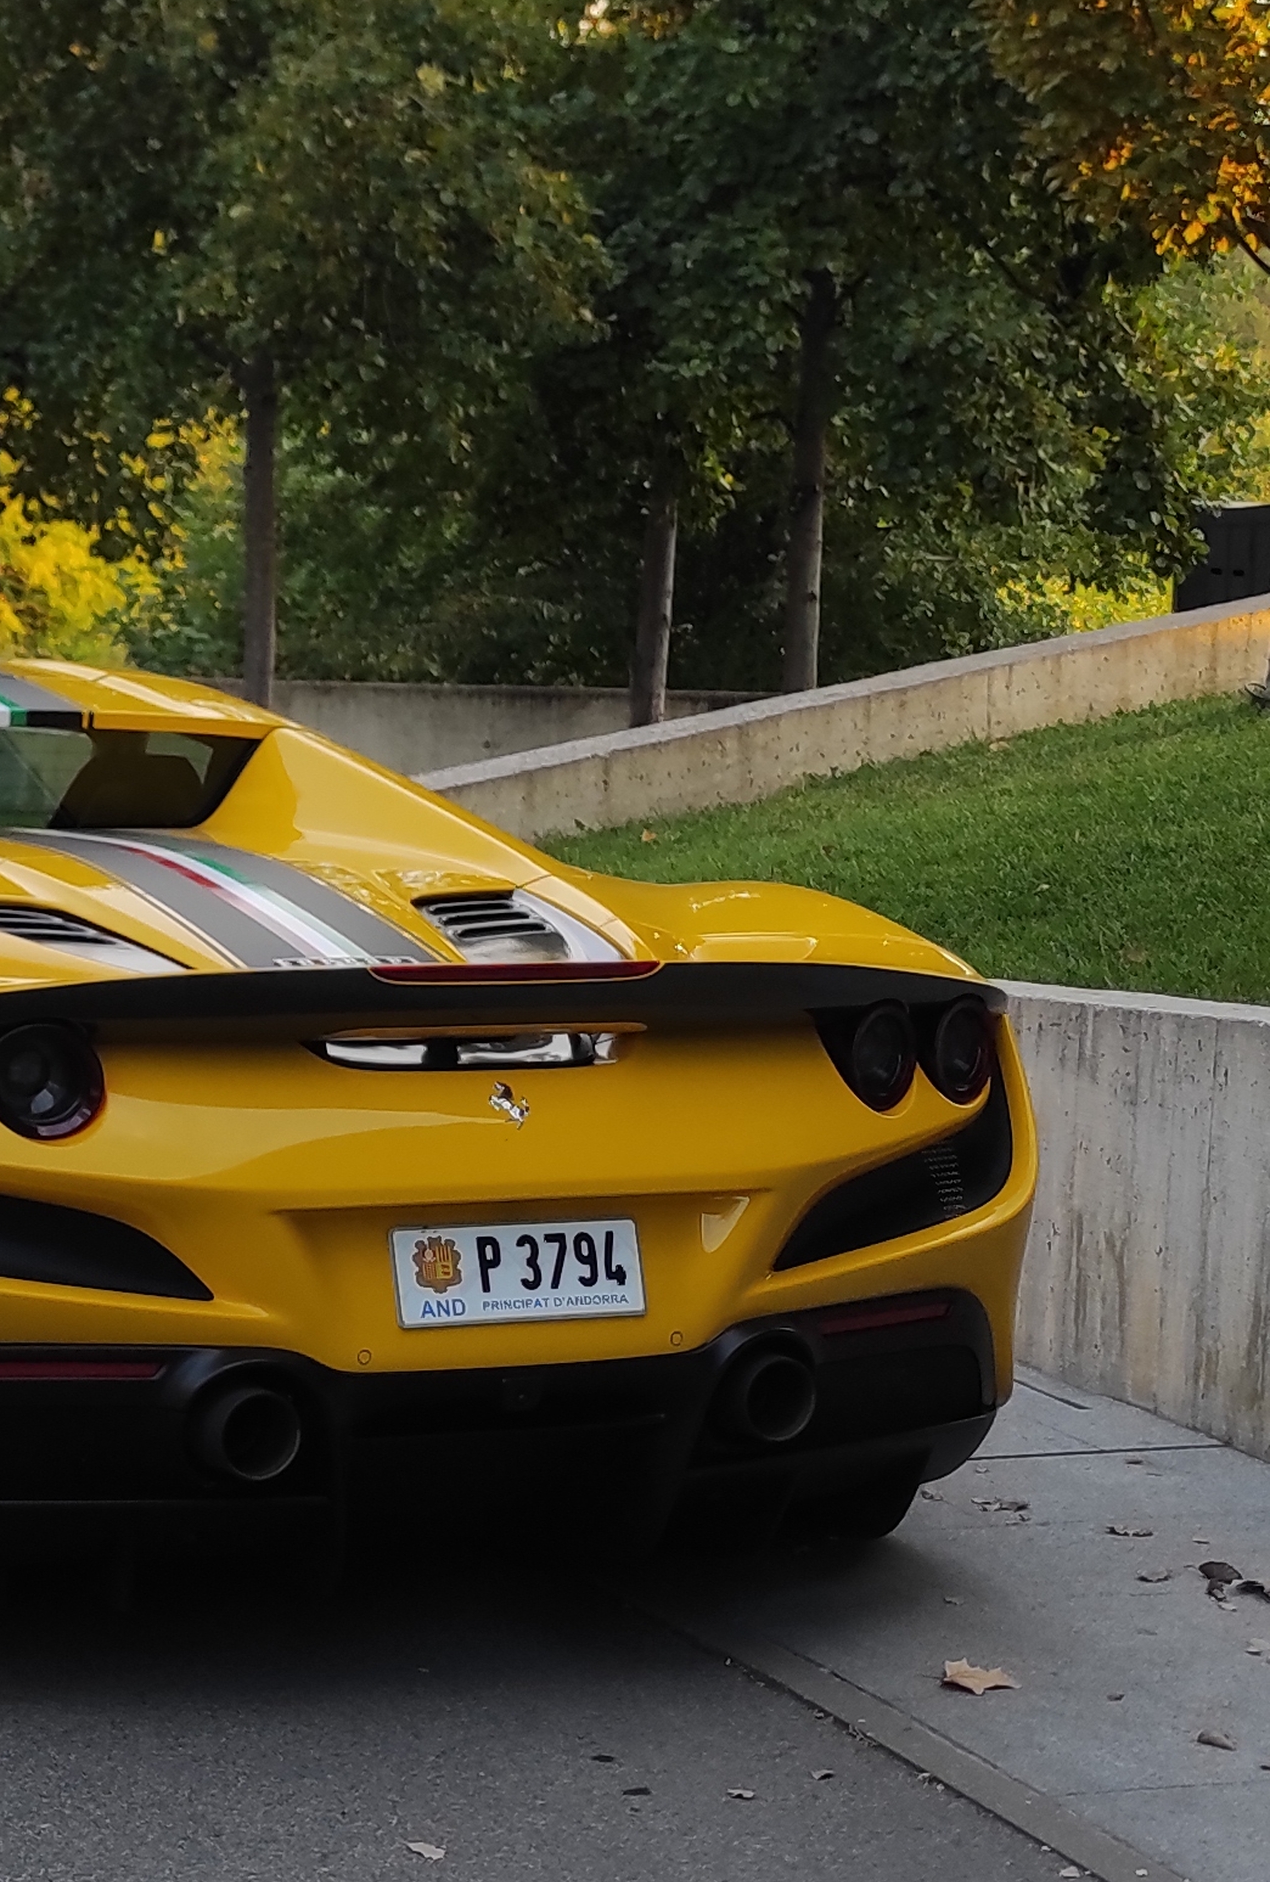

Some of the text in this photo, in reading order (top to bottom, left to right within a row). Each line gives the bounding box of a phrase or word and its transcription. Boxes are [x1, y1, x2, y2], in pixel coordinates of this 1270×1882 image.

[476, 1230, 627, 1293] P 3794
[420, 1299, 466, 1319] AND
[482, 1294, 630, 1311] PRINCIPAT D'ANDORRA
